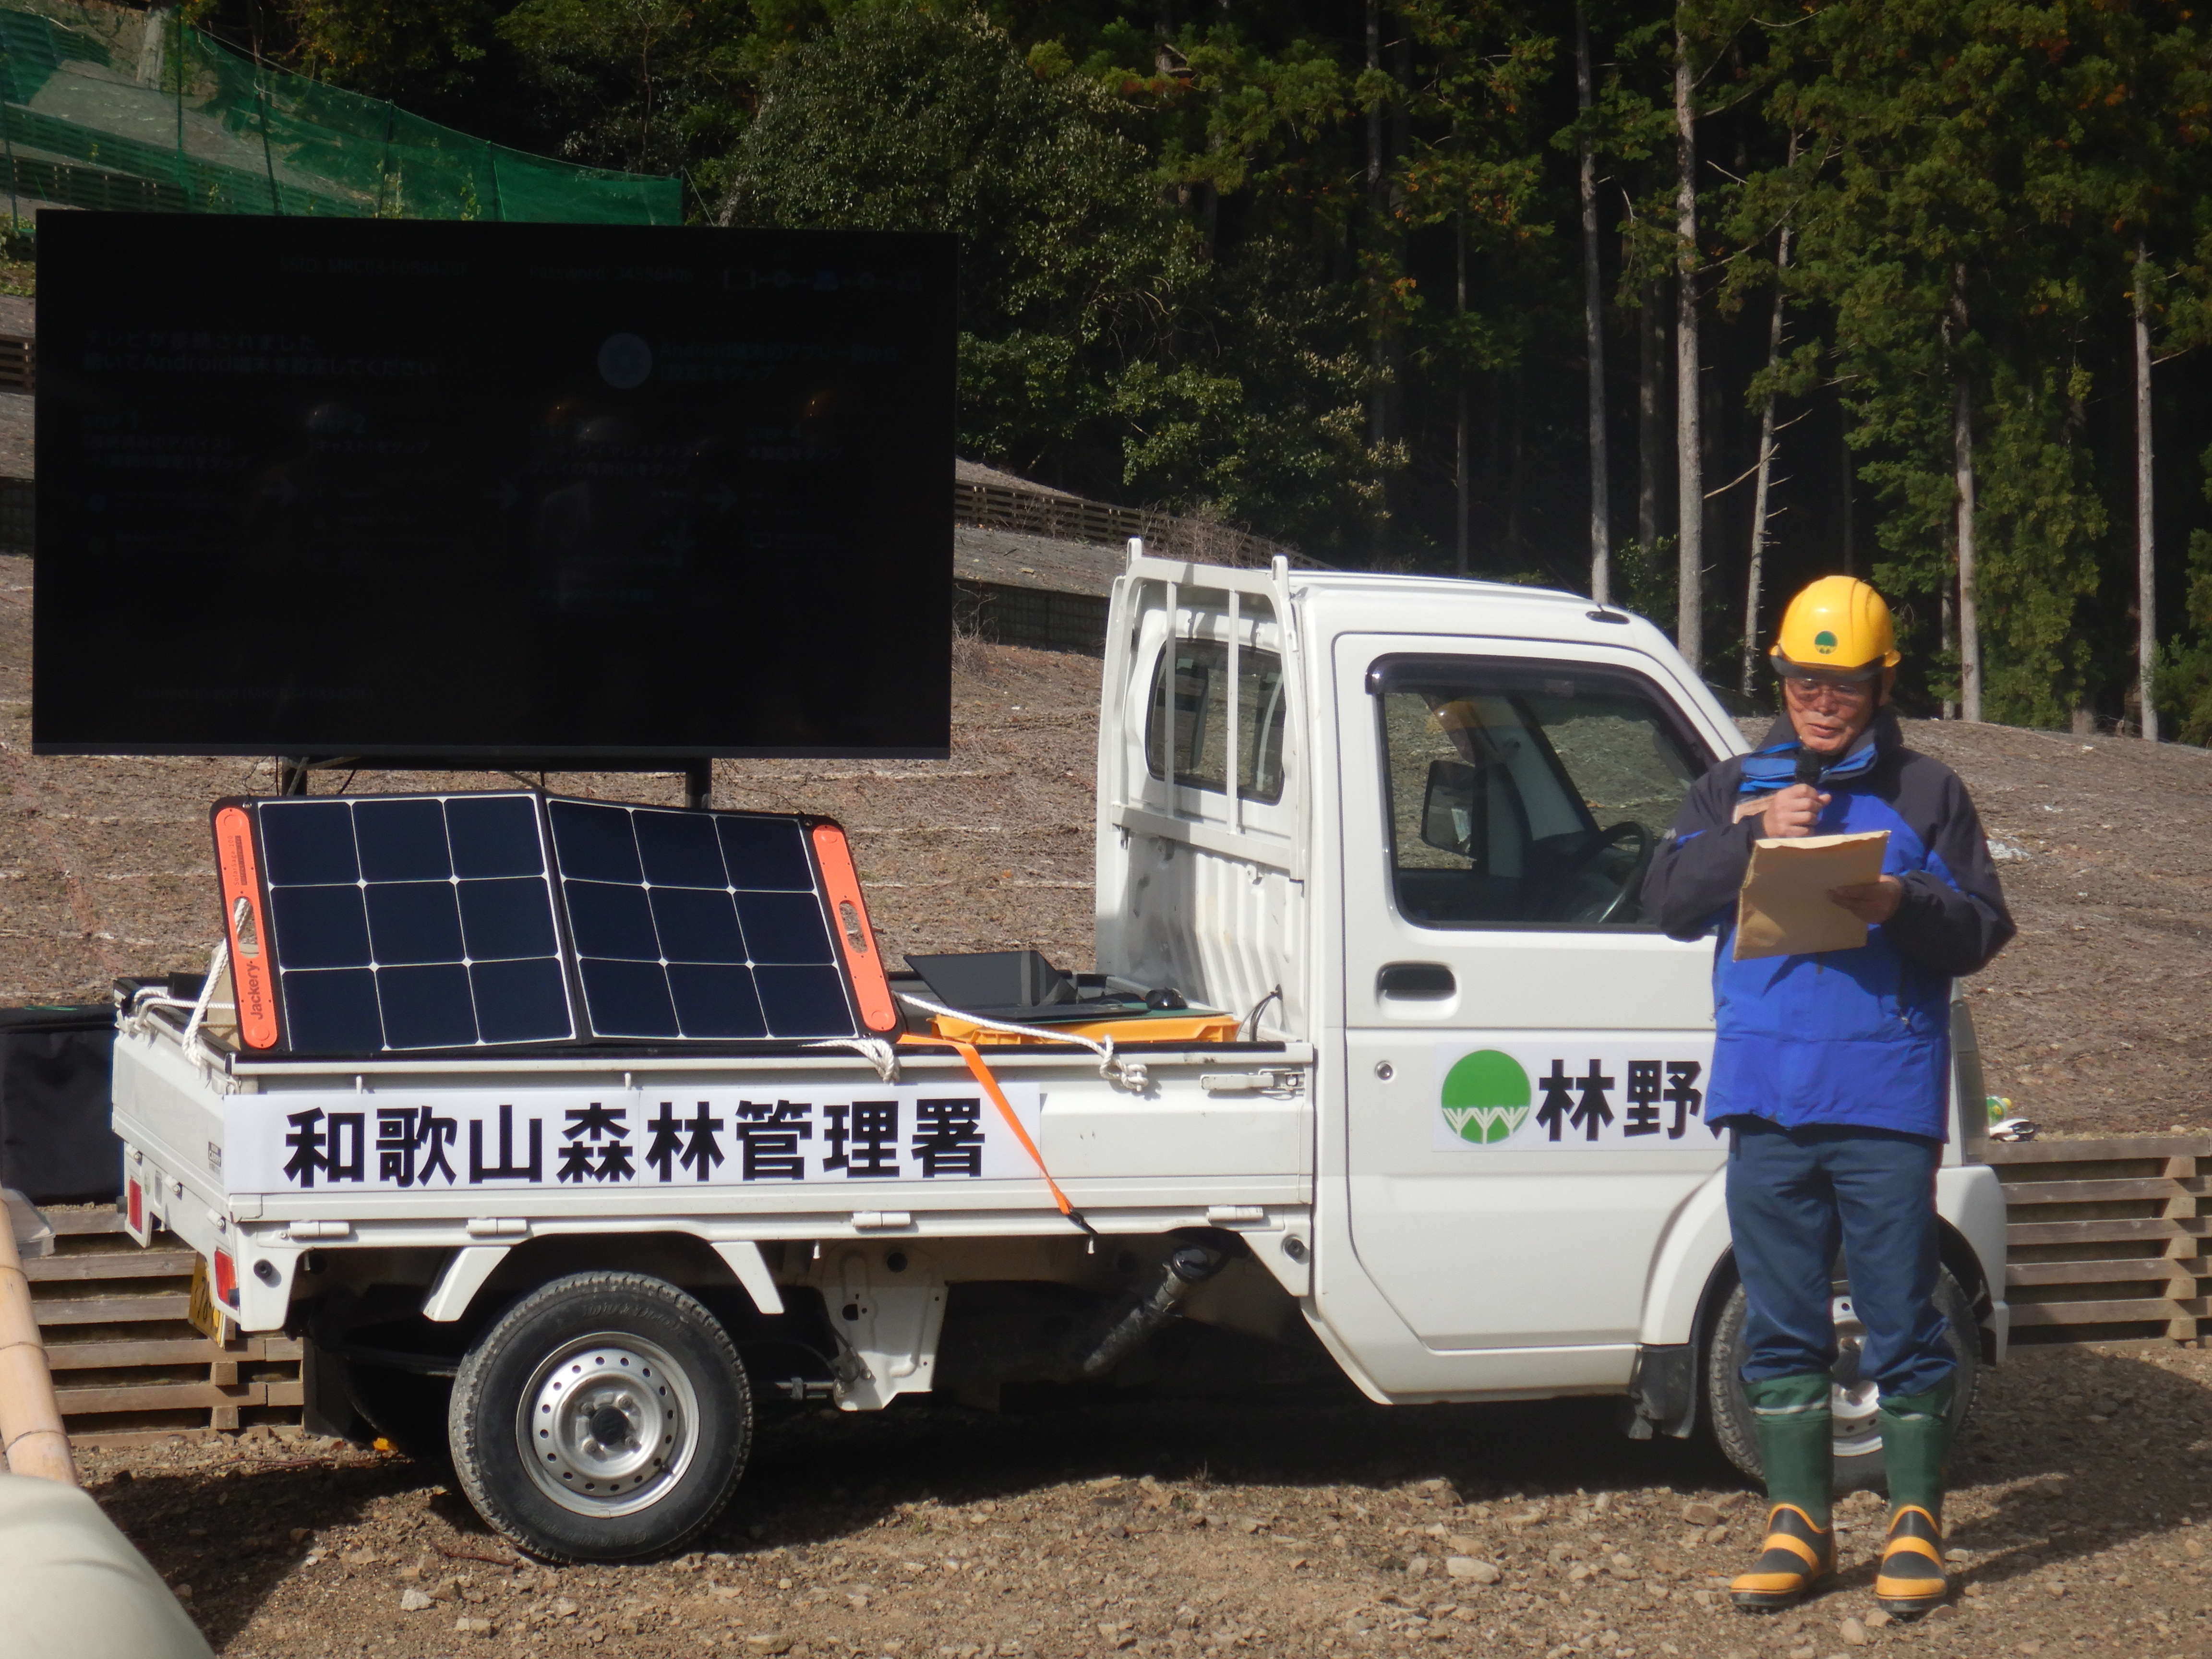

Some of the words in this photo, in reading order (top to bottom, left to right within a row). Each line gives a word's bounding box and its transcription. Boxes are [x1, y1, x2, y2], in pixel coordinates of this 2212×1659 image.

[246, 962, 264, 1021] Jackery
[1536, 1058, 1723, 1142] 林野
[283, 1098, 986, 1189] 和歌山森林管理署
